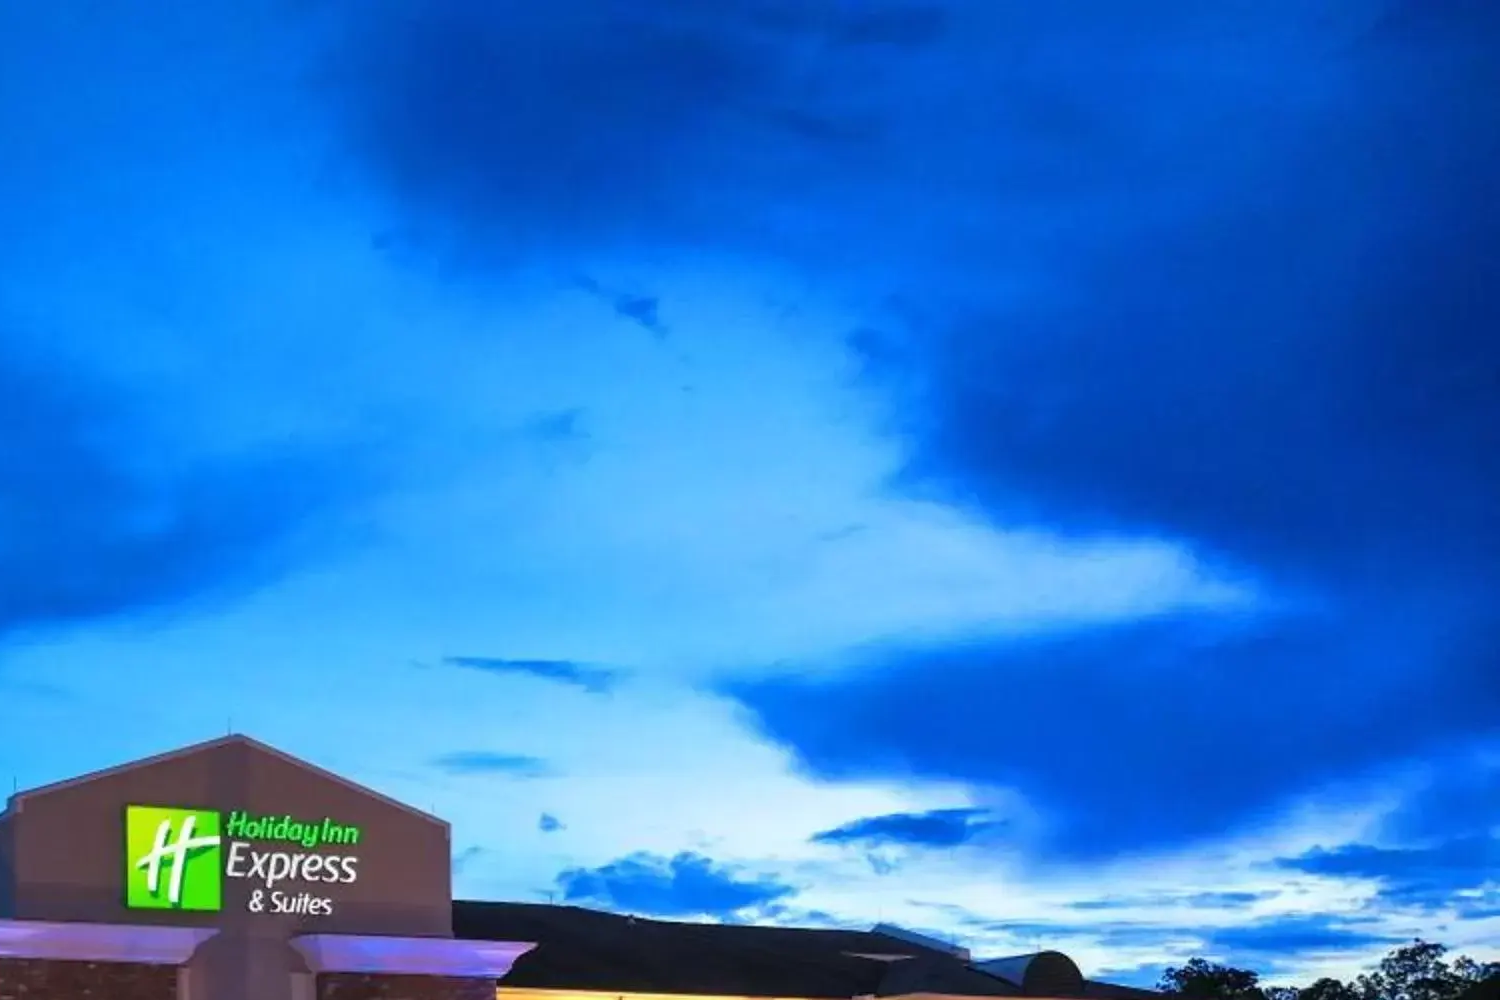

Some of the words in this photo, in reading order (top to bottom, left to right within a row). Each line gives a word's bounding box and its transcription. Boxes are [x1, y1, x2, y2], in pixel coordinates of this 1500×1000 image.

[226, 811, 319, 848] Holiday
[321, 817, 358, 844] Inn
[226, 841, 358, 889] Express
[248, 889, 265, 913] &
[269, 891, 333, 916] Suites
